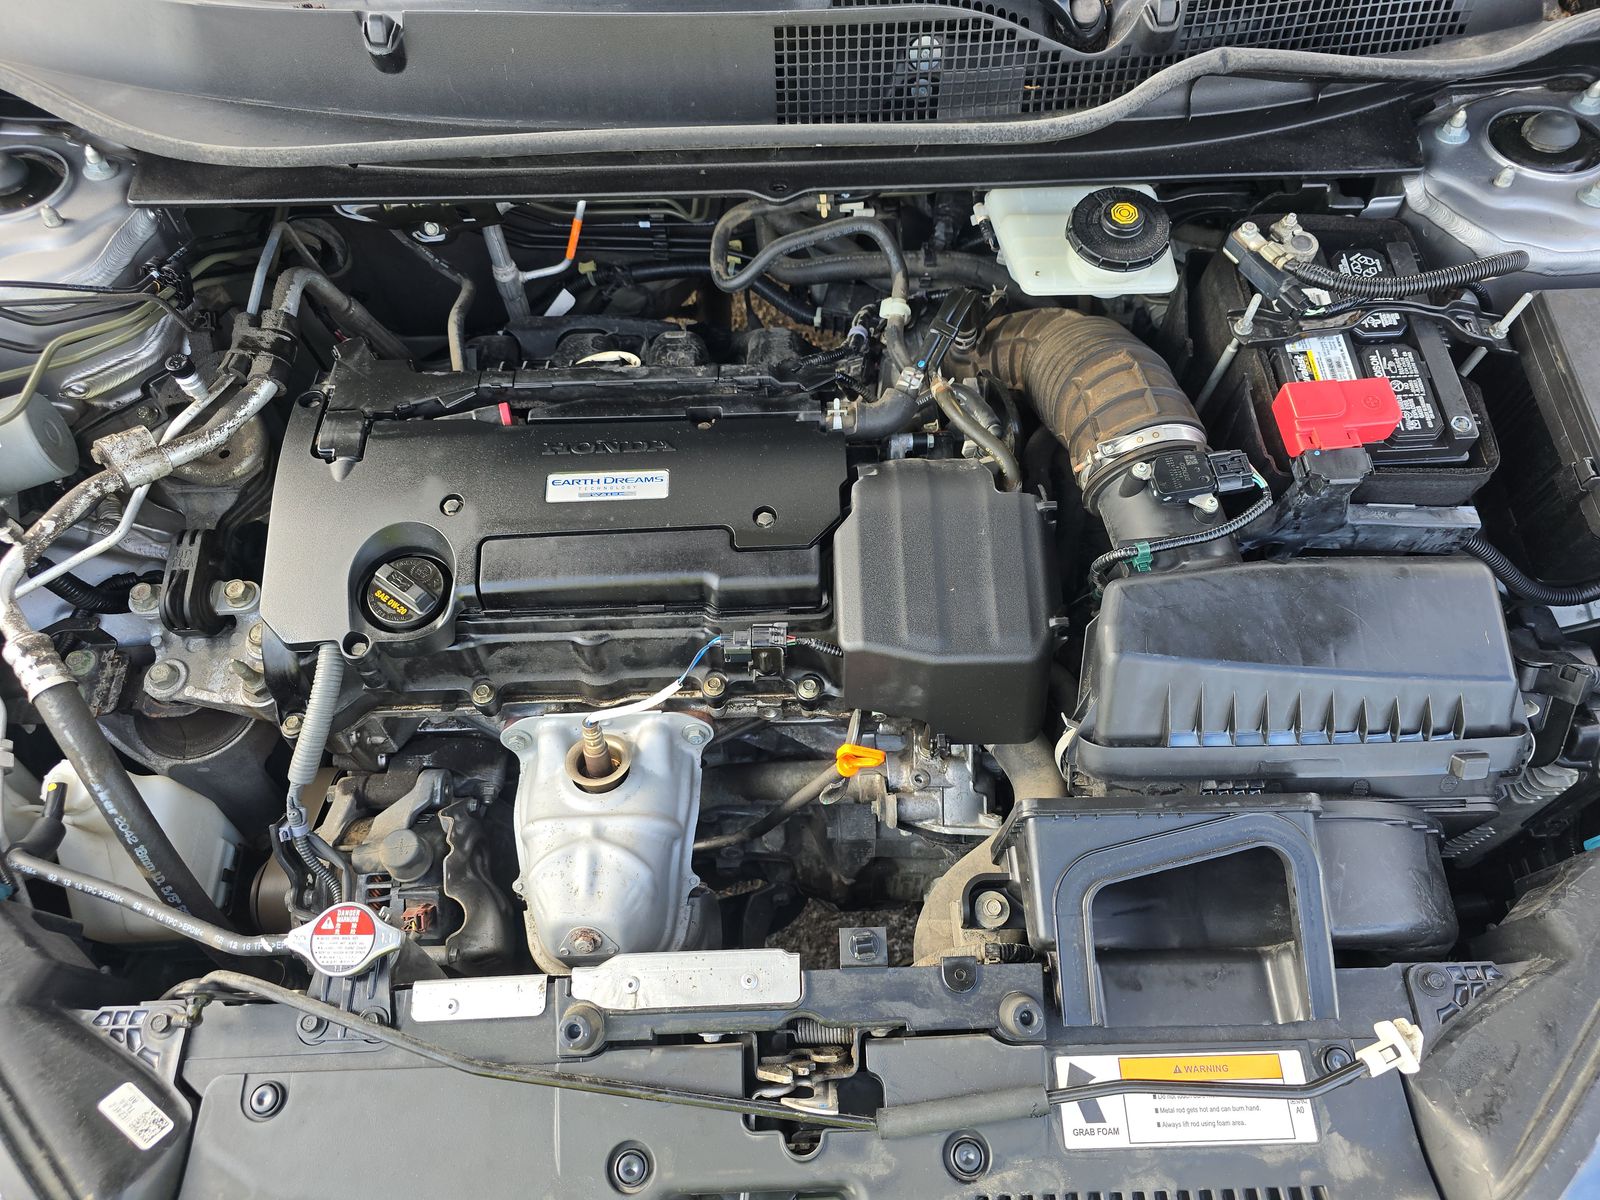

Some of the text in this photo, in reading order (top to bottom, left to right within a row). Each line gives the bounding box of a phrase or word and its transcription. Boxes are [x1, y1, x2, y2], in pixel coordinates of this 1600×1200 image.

[1369, 355, 1383, 378] OISON
[541, 440, 677, 455] HONDA
[551, 476, 664, 487] EARTH DREAMS
[374, 590, 390, 602] SAE
[387, 599, 408, 615] 0W-20
[84, 884, 97, 895] TPC
[165, 915, 178, 927] TPC
[228, 940, 238, 950] 12
[1183, 1064, 1229, 1073] WARNING
[1186, 1107, 1198, 1115] gets
[1162, 1121, 1181, 1129] Always
[1200, 1121, 1216, 1129] using
[1072, 1127, 1120, 1136] GRAB FOAM
